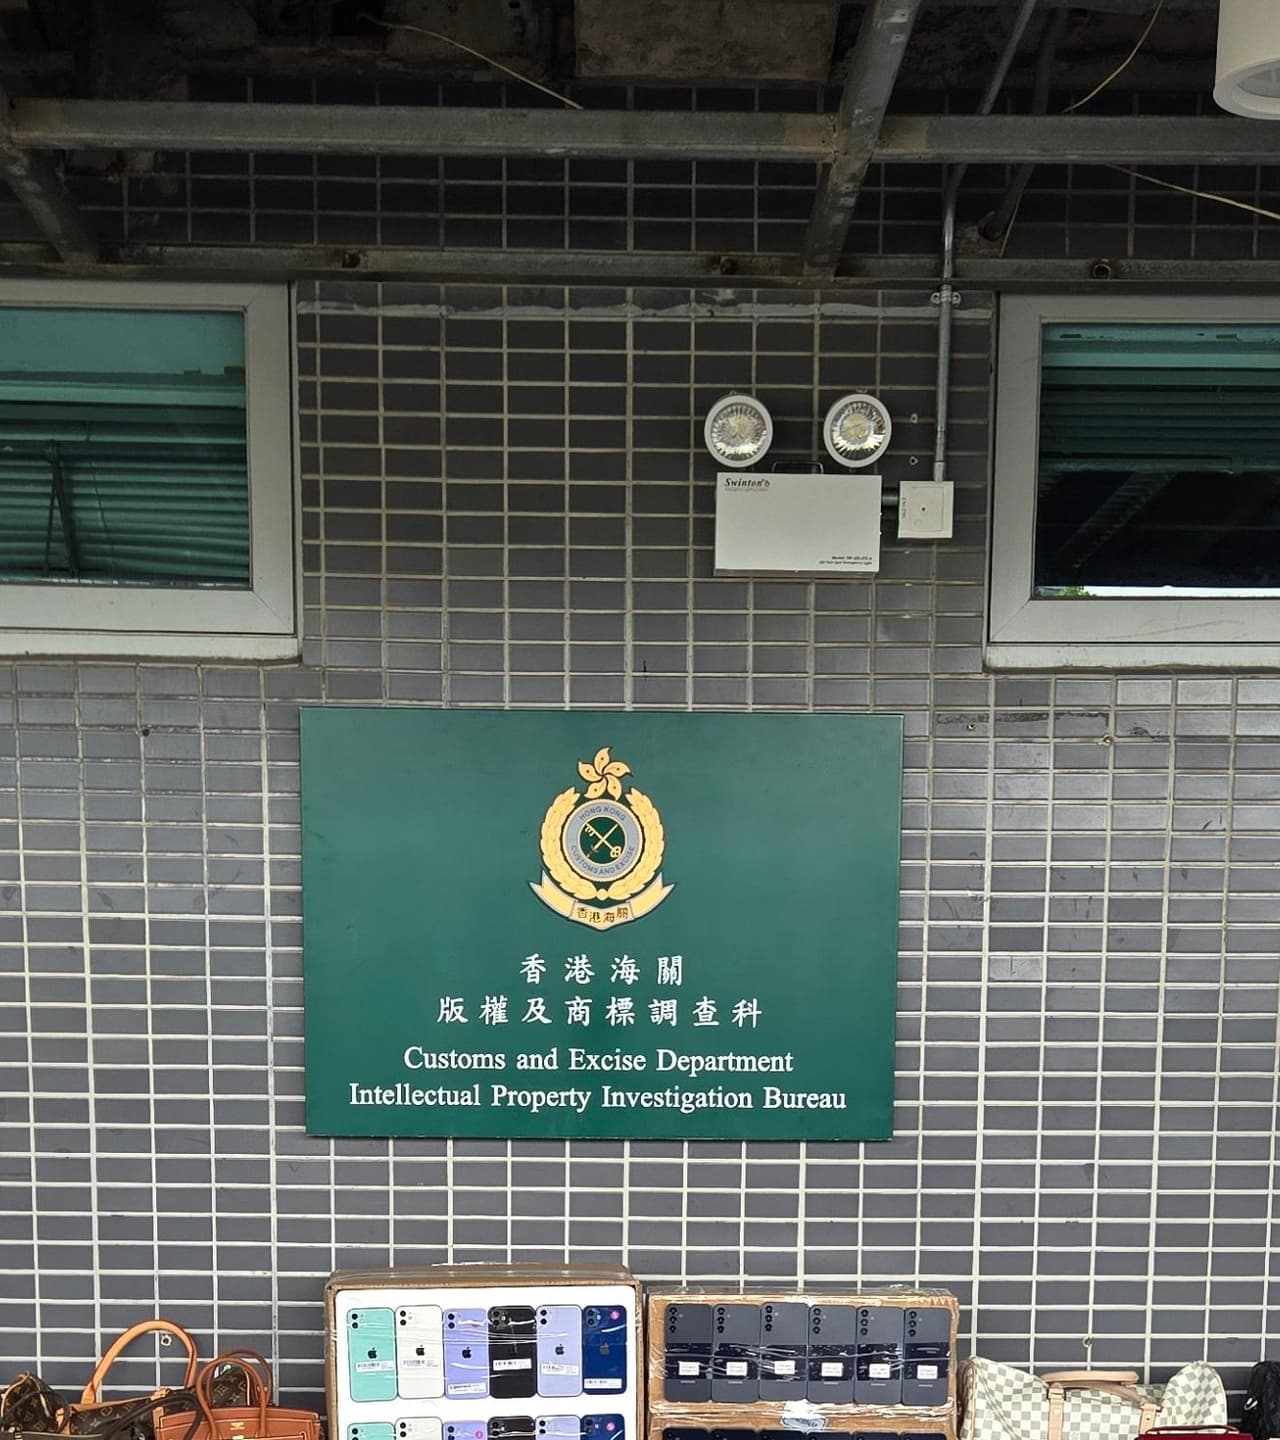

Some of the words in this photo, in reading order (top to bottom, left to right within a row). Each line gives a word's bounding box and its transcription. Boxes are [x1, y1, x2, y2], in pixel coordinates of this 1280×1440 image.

[724, 478, 763, 488] Swinton
[579, 805, 602, 822] HONG
[603, 805, 626, 822] KONG
[571, 844, 599, 875] CUSTOMS
[599, 867, 616, 875] AND
[615, 846, 635, 870] EXCISE
[520, 953, 683, 986] 香港海關
[437, 994, 762, 1028] 版權及商標調查科
[404, 1046, 506, 1071] Customs
[516, 1047, 559, 1070] and
[568, 1047, 647, 1071] Excise
[656, 1048, 794, 1077] Department
[349, 1082, 481, 1106] Intellectual
[491, 1084, 592, 1113] Property
[601, 1085, 754, 1114] Investigation
[762, 1086, 848, 1110] Bureau
